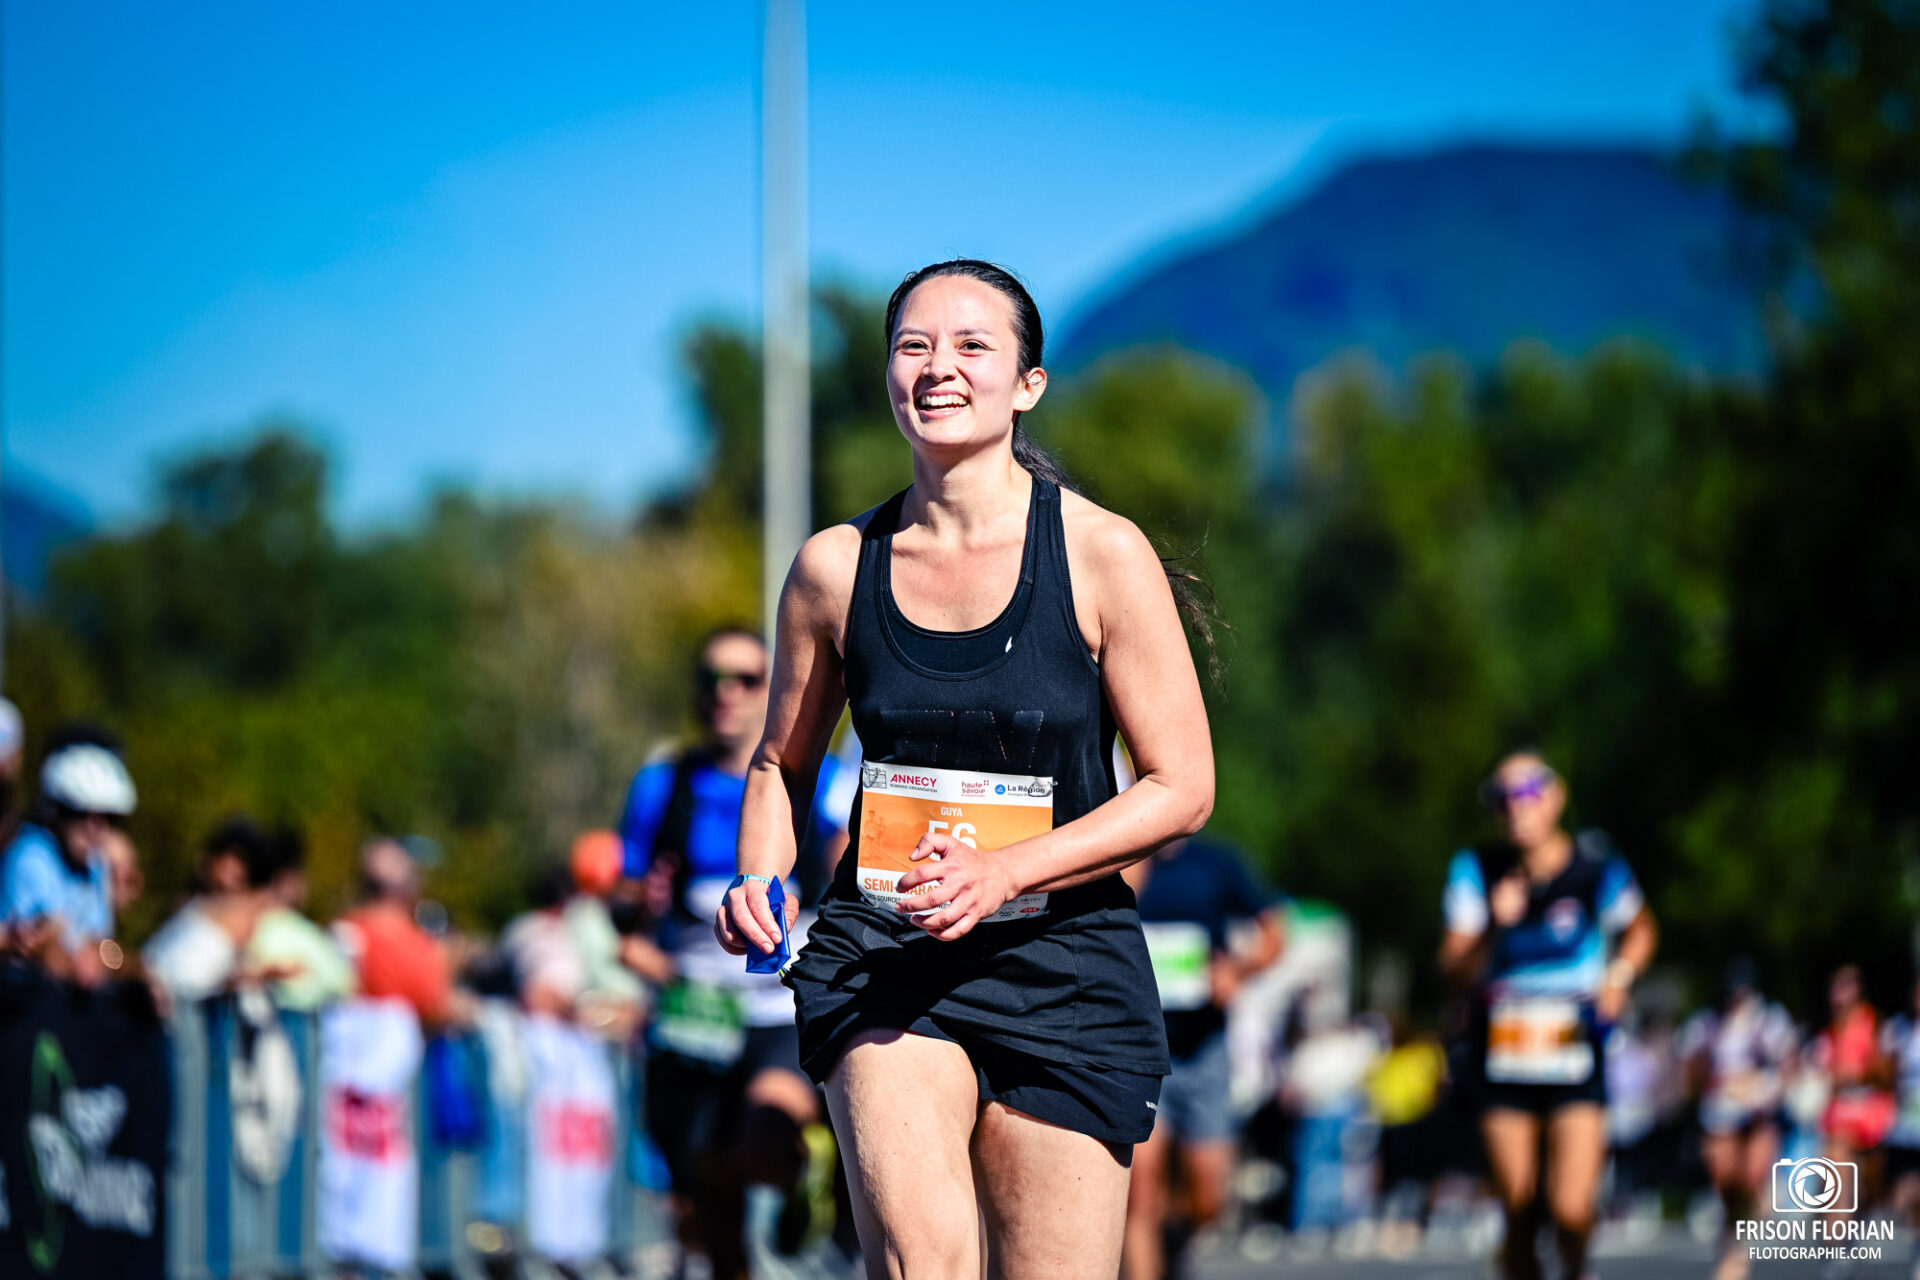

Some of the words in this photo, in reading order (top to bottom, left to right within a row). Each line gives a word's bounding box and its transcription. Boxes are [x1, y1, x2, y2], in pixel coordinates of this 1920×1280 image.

[890, 773, 937, 787] ANNECY
[1018, 785, 1045, 794] Région
[940, 806, 963, 817] GUYA
